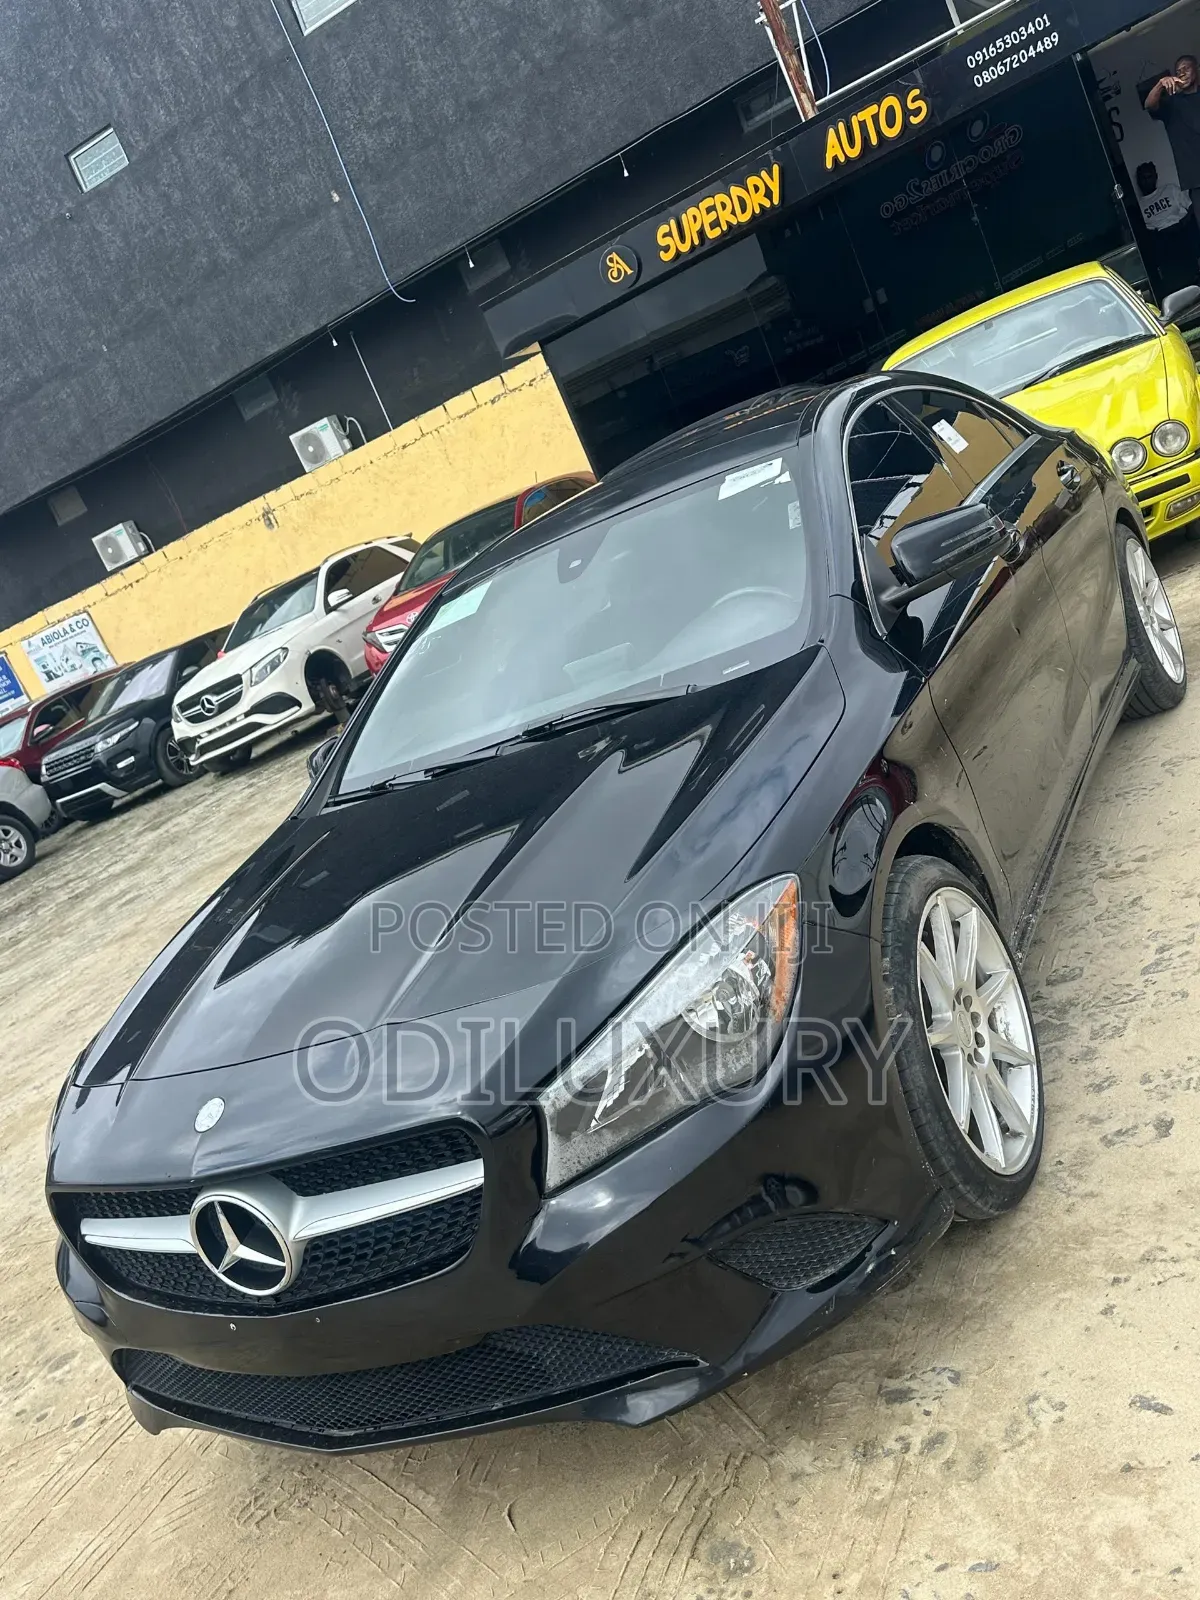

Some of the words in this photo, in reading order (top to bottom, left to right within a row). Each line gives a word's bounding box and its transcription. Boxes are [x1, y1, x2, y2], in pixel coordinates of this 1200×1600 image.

[967, 14, 1050, 68] 09165303401
[974, 32, 1059, 87] 08067204489
[656, 163, 782, 263] SUPERDRY
[1143, 197, 1172, 219] SPACE
[40, 627, 68, 647] ABIOLA
[68, 623, 77, 633] &
[75, 618, 90, 629] CO
